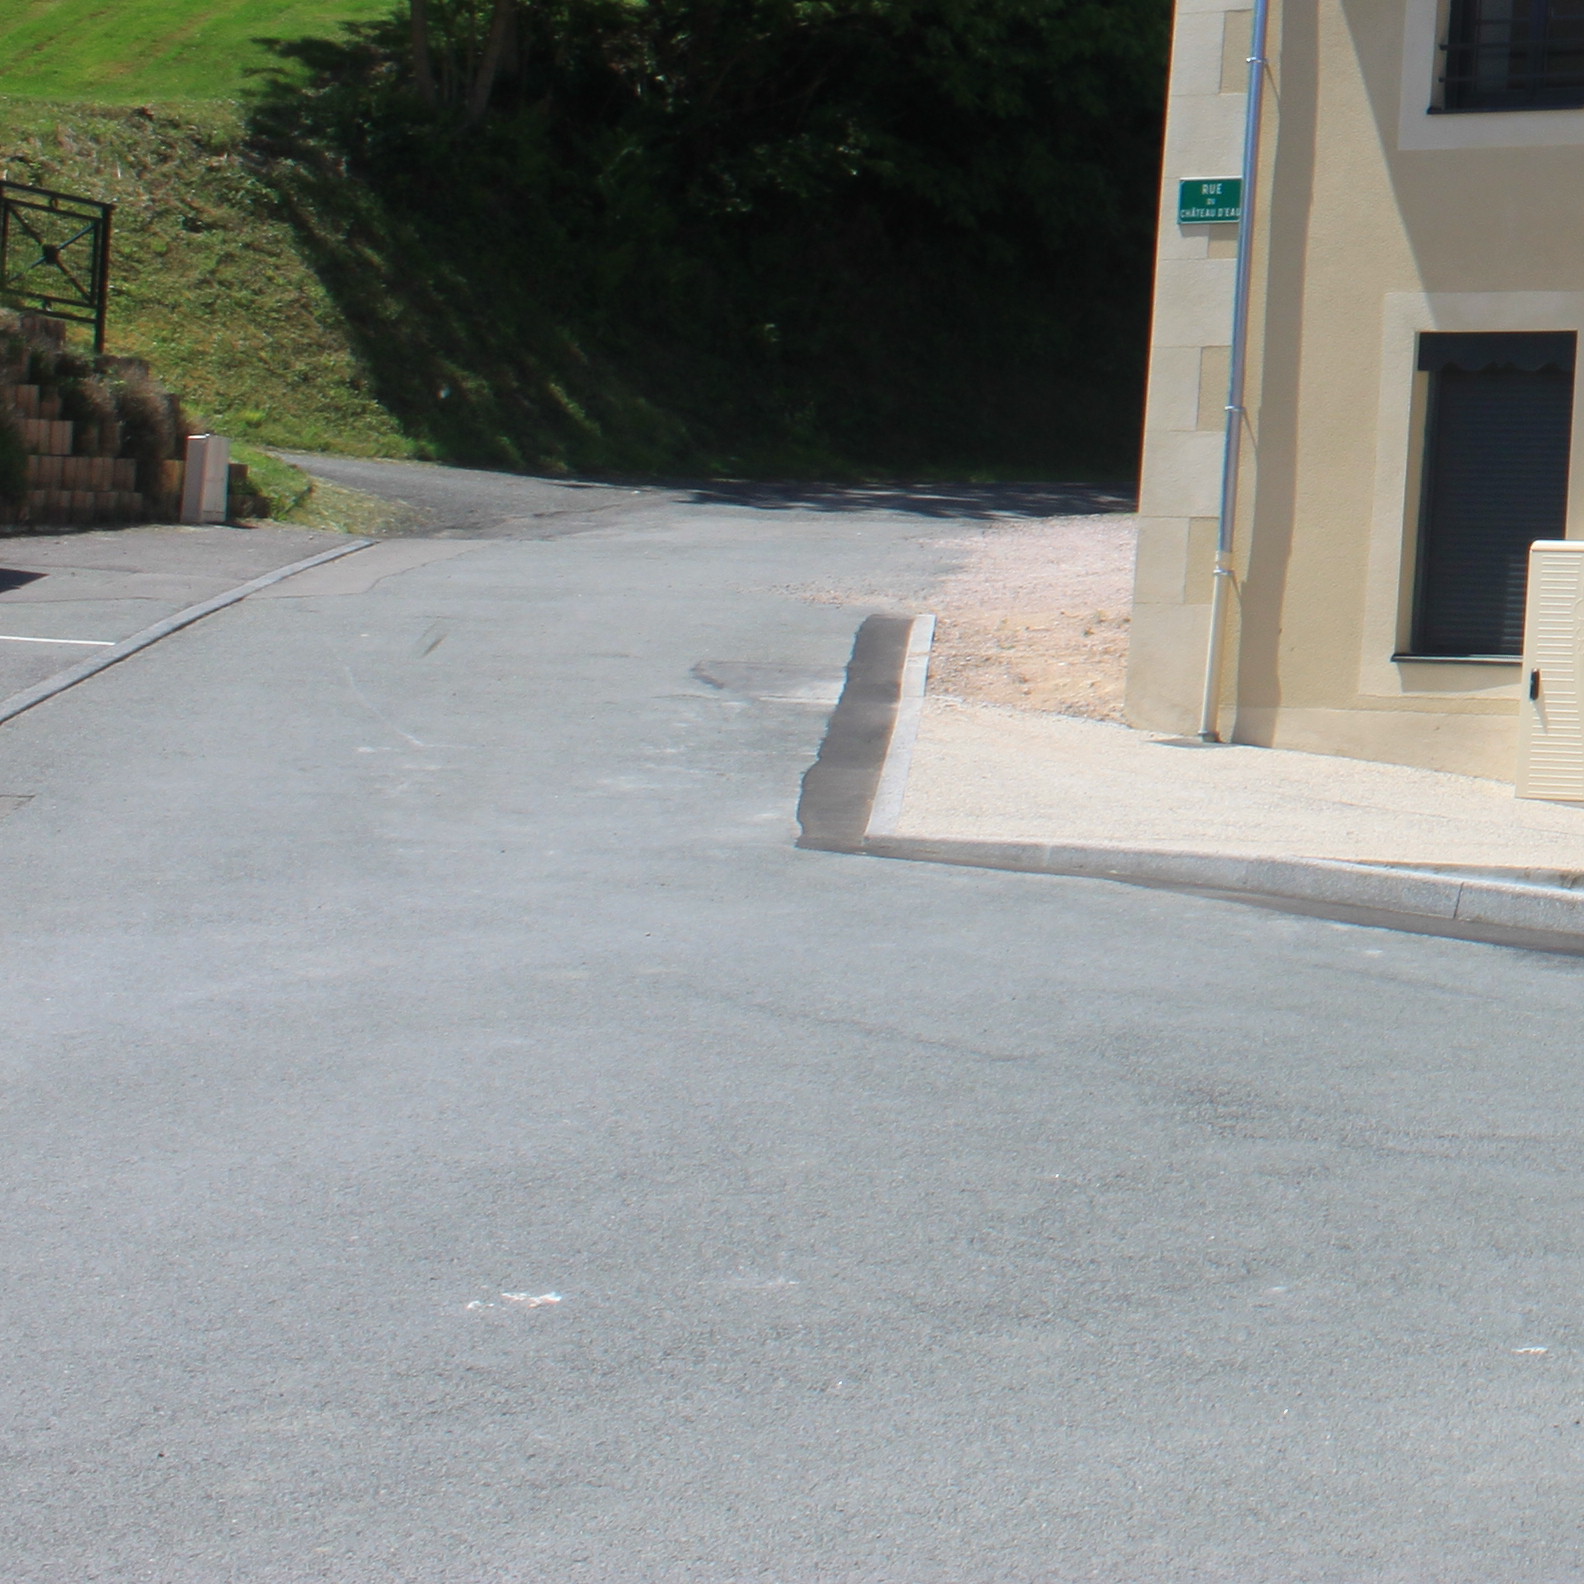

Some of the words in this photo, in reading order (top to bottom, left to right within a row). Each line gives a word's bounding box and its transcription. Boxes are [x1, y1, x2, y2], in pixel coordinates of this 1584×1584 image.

[1201, 183, 1222, 194] RUE
[1180, 207, 1216, 218] CHÂTEAU
[1217, 207, 1242, 217] D'EAU
